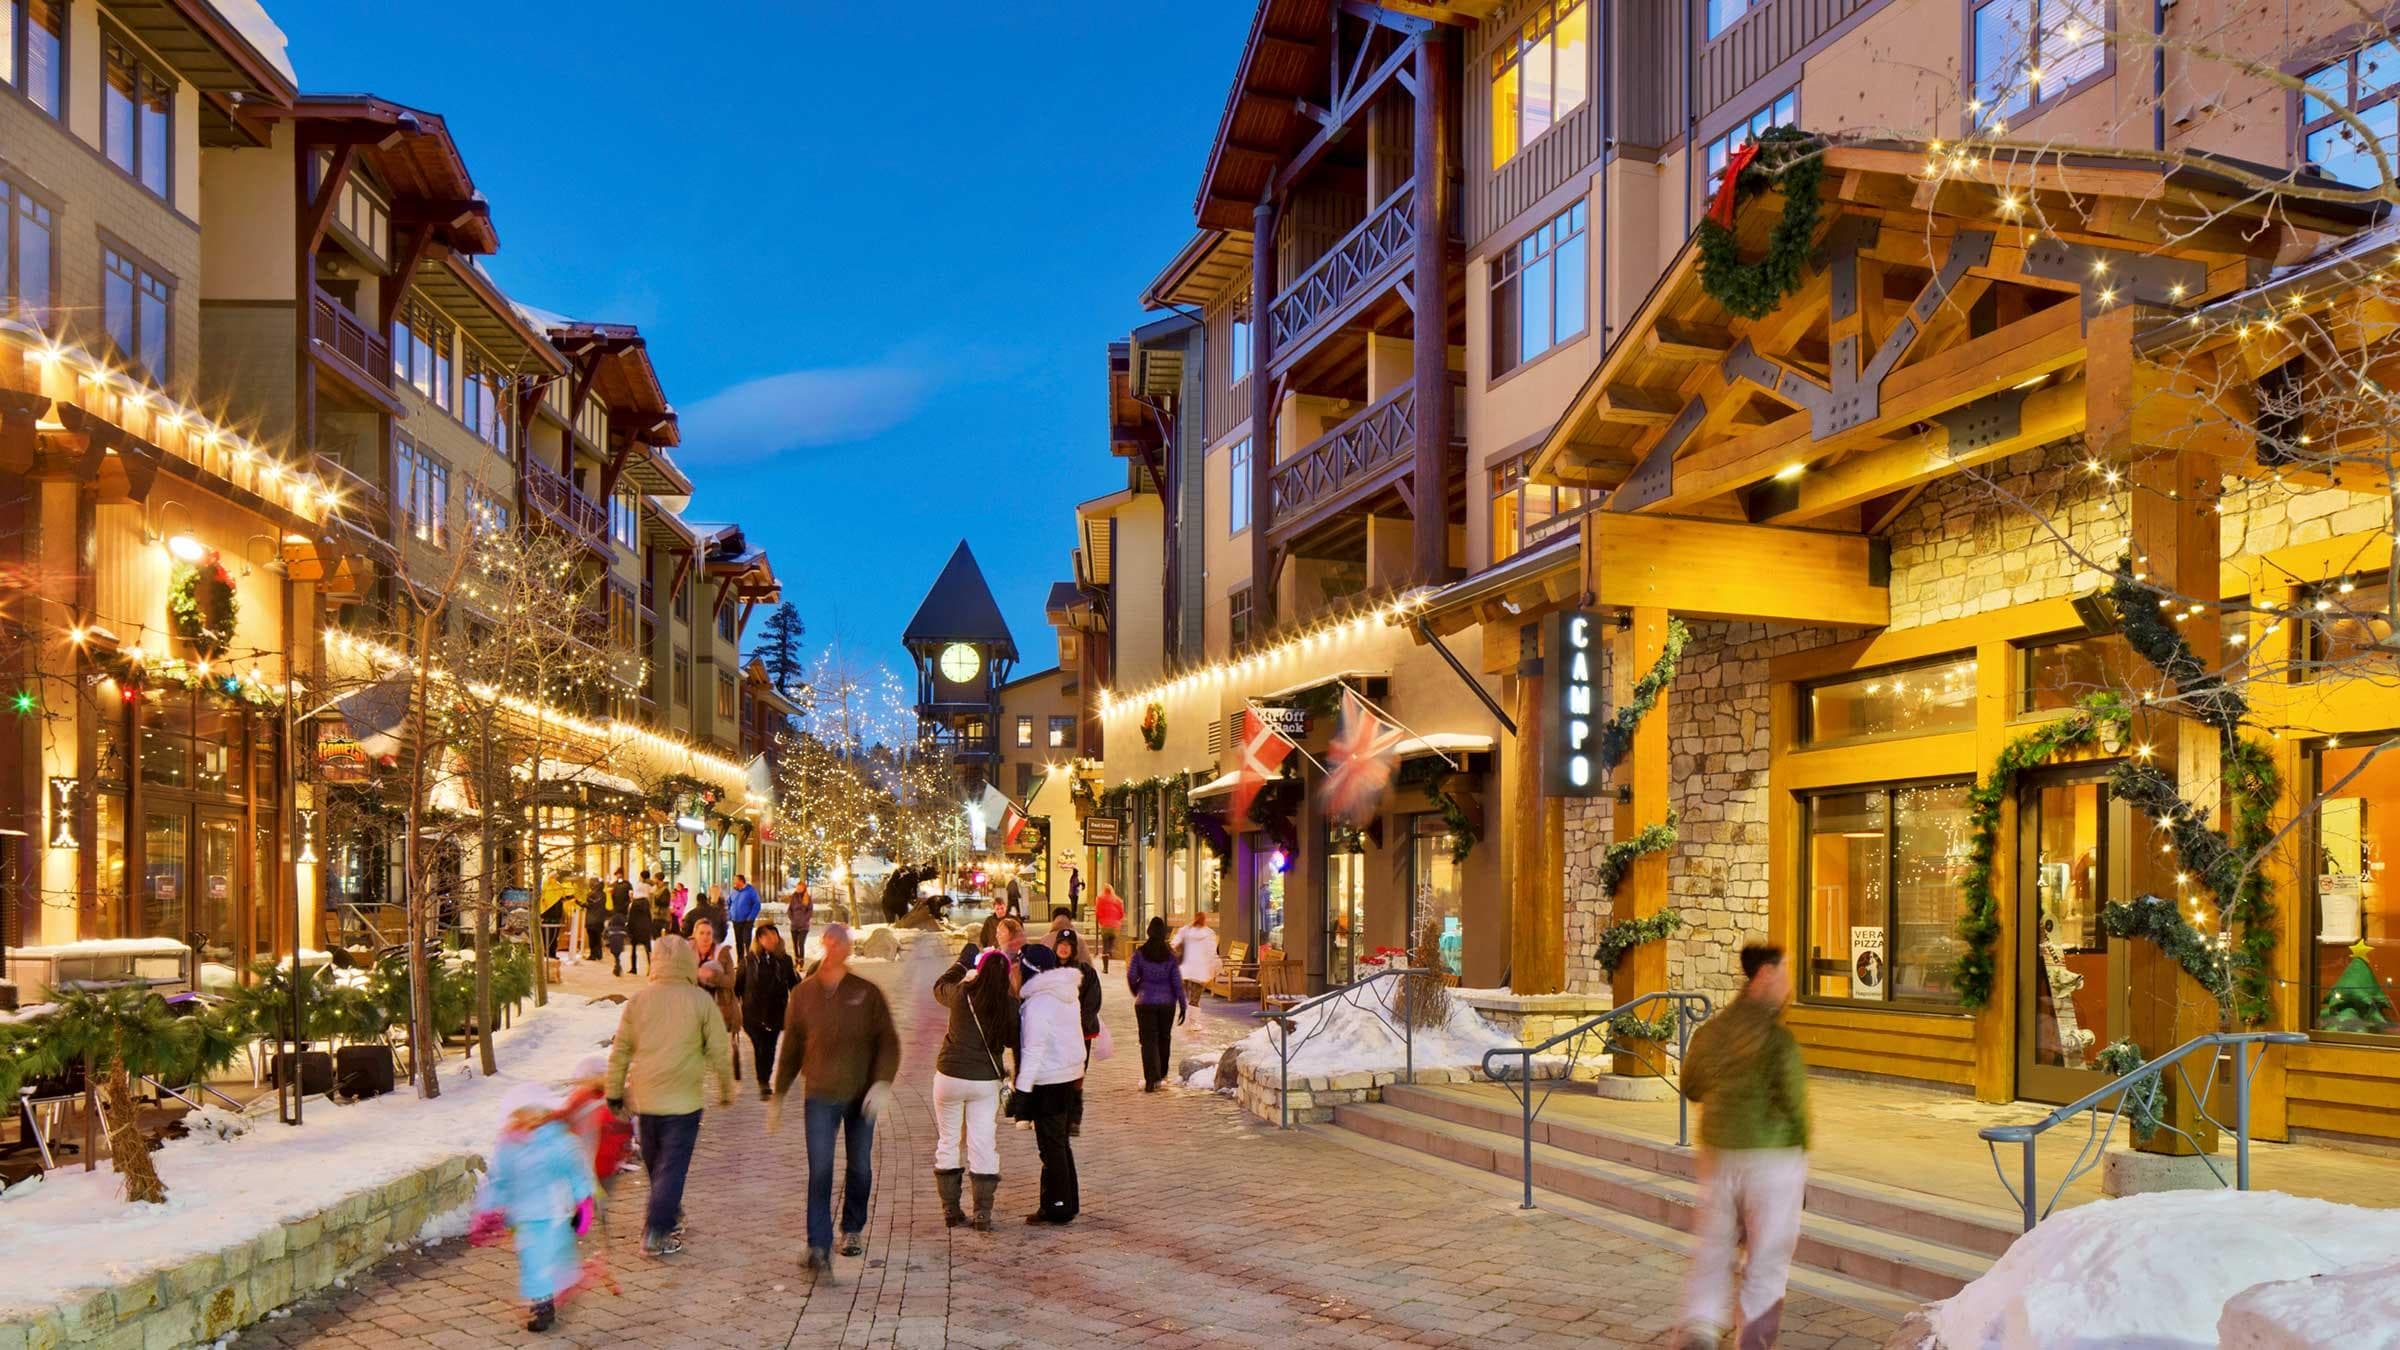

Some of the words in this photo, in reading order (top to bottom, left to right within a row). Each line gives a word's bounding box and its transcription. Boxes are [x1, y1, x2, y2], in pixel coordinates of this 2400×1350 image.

[1570, 617, 1590, 786] CAMPO
[1854, 930, 1884, 939] VERA
[1854, 940, 1885, 948] PIZZA
